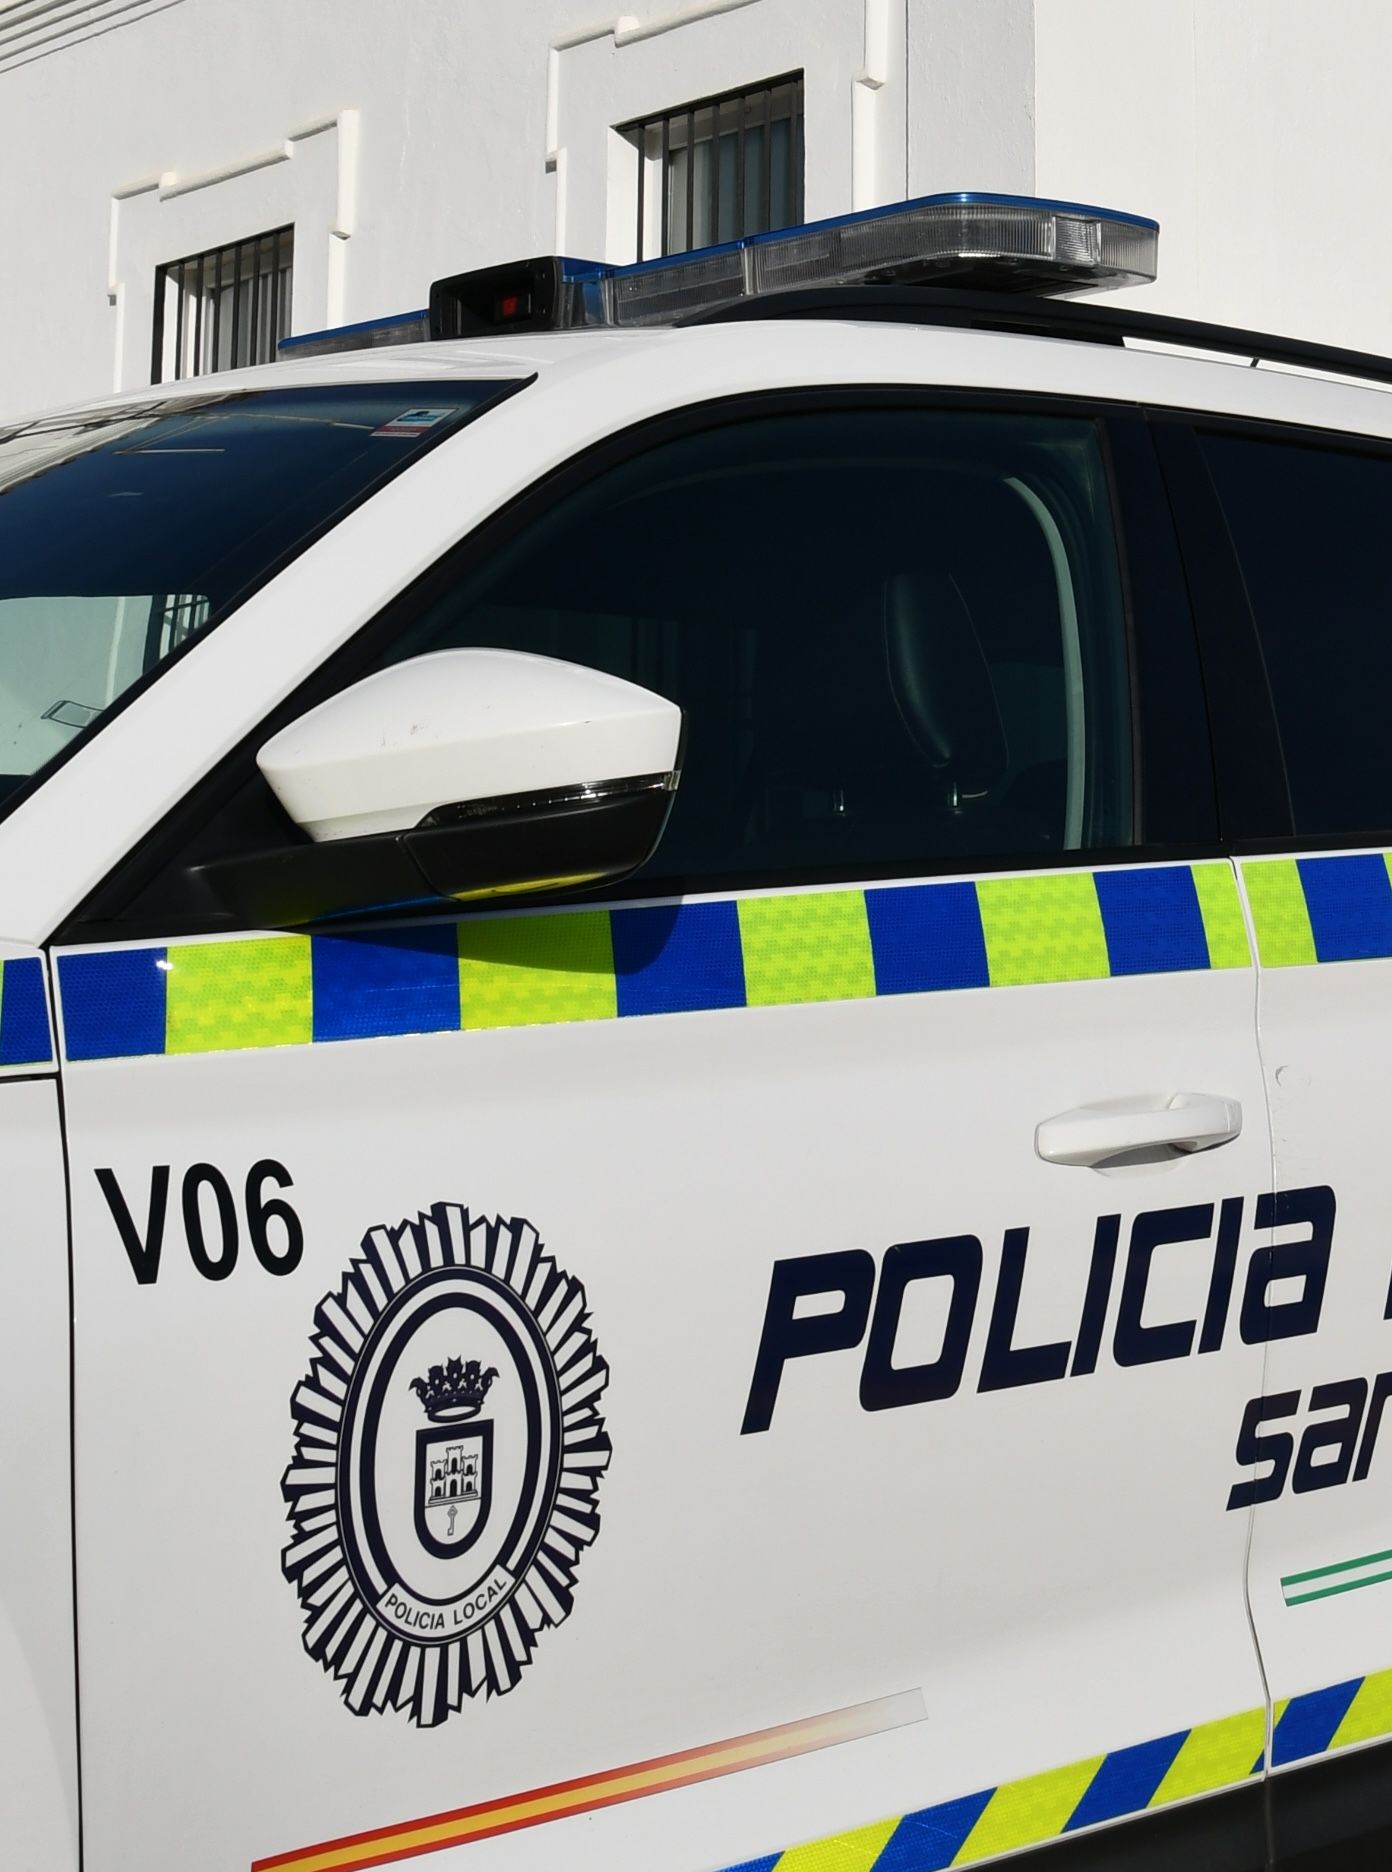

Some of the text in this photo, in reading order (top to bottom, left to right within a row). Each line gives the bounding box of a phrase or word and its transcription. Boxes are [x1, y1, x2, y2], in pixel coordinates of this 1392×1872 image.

[93, 1158, 304, 1285] V06
[384, 1578, 507, 1630] POLICIA LOCAL
